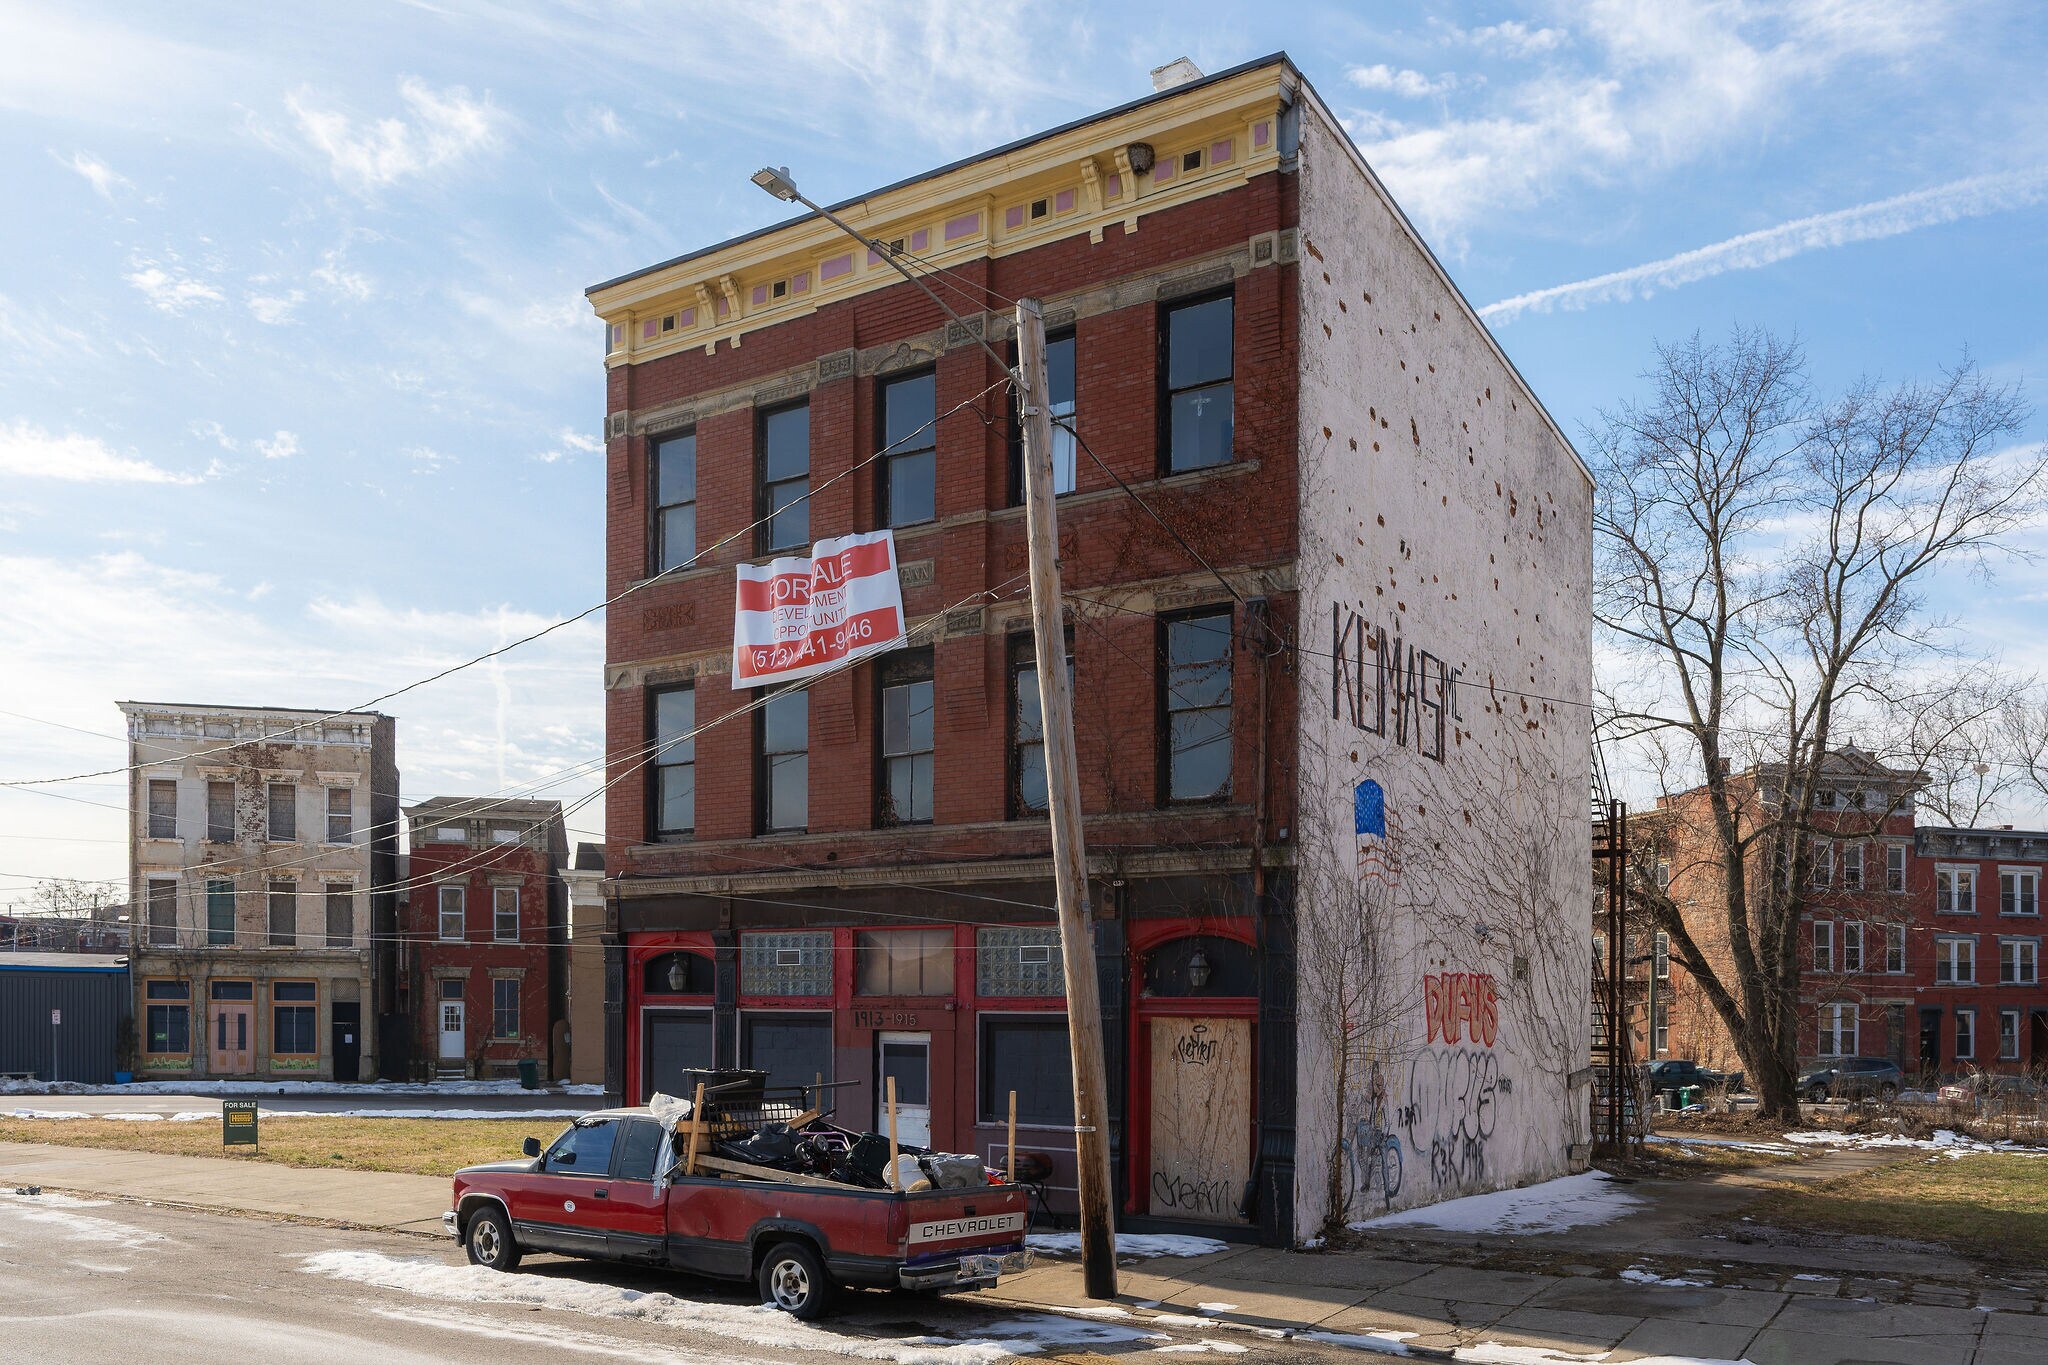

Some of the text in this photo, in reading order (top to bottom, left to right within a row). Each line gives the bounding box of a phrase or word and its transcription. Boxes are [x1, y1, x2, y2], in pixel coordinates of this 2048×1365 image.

[769, 553, 852, 605] FOR ALE
[772, 585, 847, 624] DEVELPMENT
[752, 646, 794, 673] (513)
[854, 1011, 917, 1028] 1913-1915
[922, 1216, 1014, 1238] CHEVROLET
